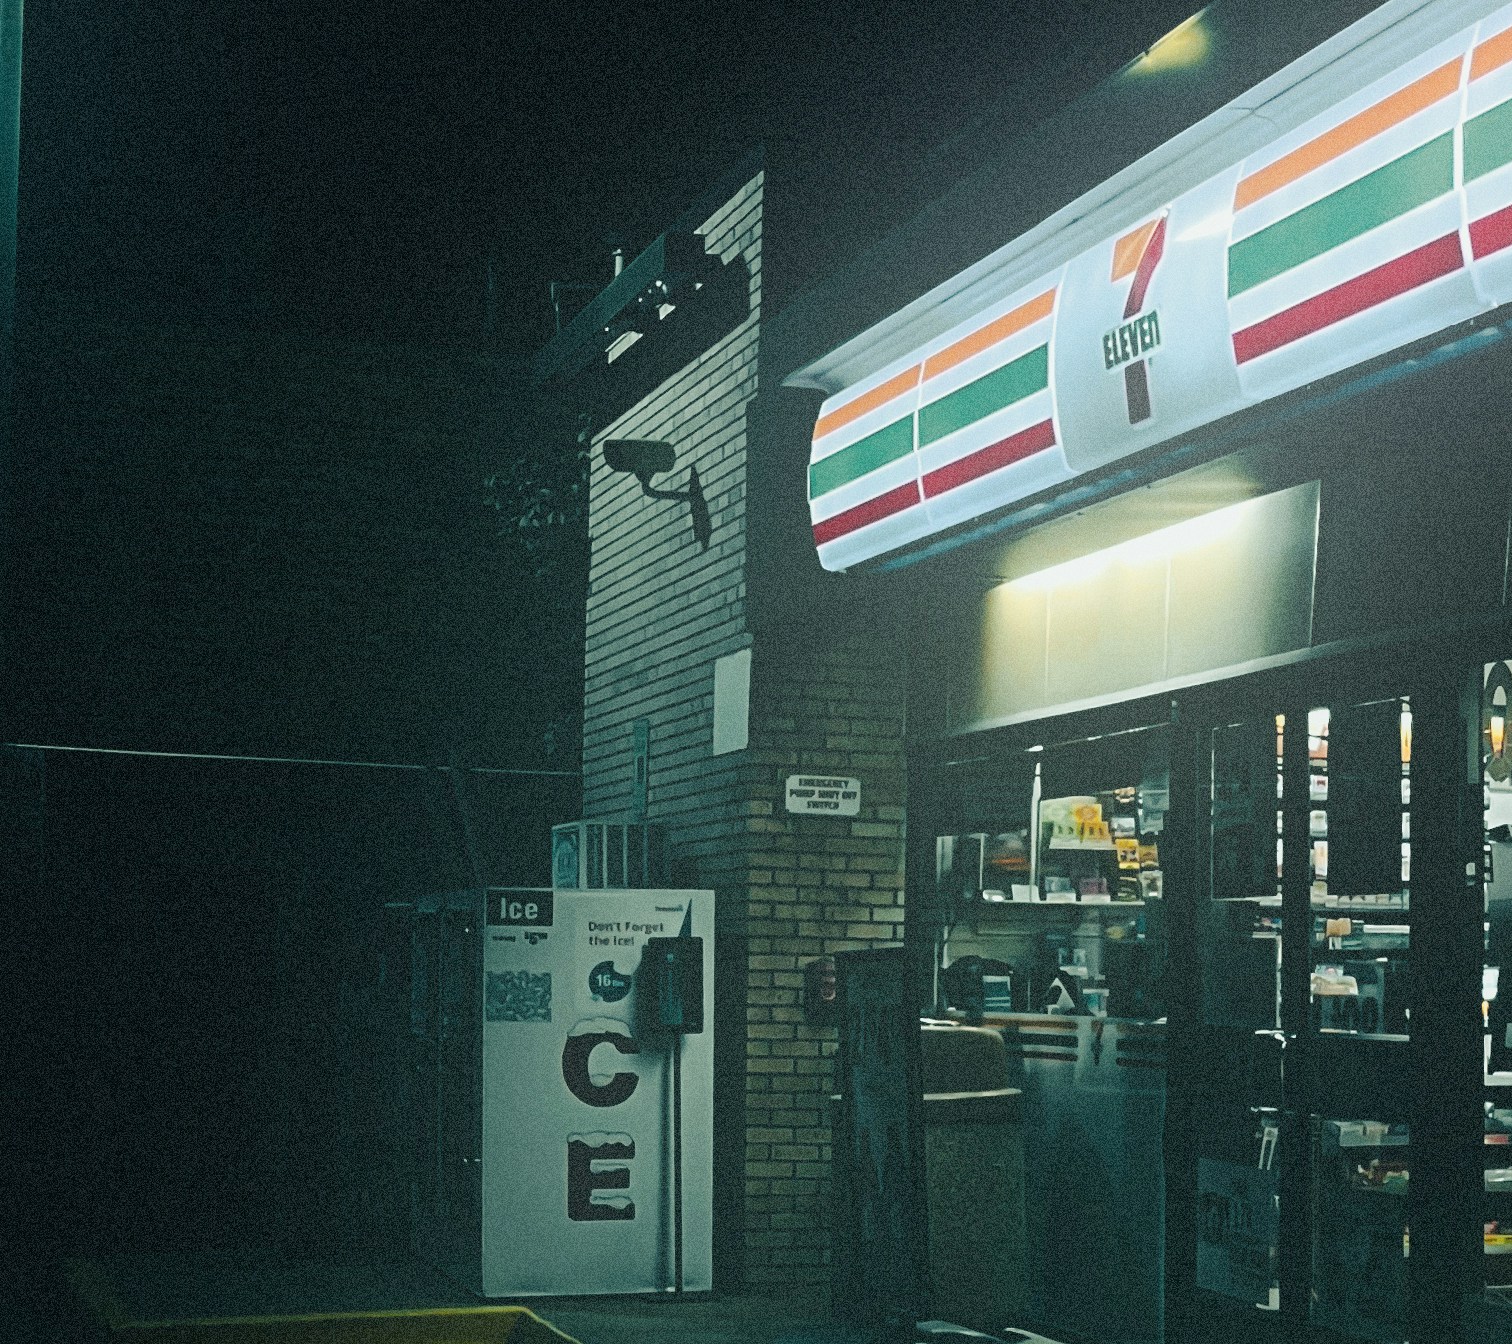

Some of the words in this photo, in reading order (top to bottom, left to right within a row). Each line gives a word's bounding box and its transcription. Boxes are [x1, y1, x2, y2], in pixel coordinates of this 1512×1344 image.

[500, 898, 538, 920] Ice
[588, 921, 621, 932] Don't
[625, 921, 664, 935] Forget
[588, 935, 610, 946] the
[595, 973, 612, 987] 16
